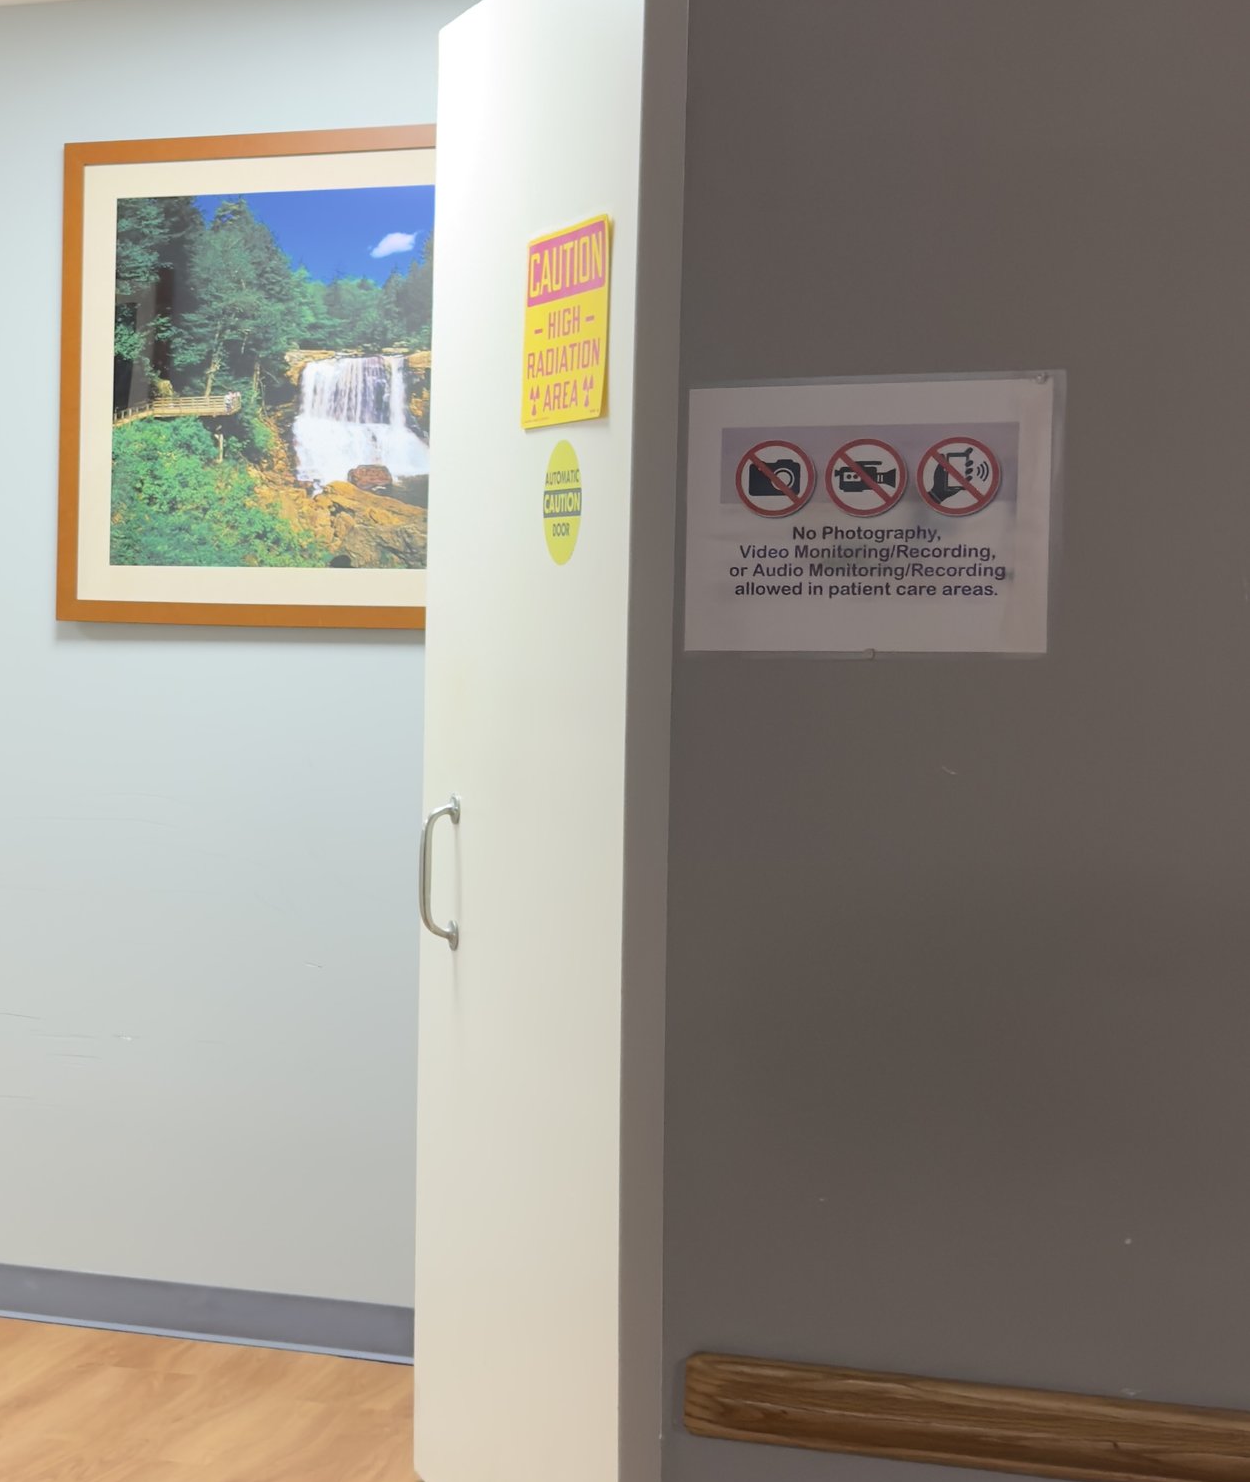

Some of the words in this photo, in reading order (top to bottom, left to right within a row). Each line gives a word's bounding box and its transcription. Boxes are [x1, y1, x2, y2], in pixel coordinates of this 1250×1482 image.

[530, 230, 603, 299] CAUTION
[548, 305, 580, 339] HIGH
[527, 337, 600, 380] RADIATION
[543, 379, 579, 412] AREA
[545, 468, 580, 485] AUTOMATIC
[544, 492, 581, 514] CAUTION
[552, 522, 570, 537] DOOR
[792, 526, 817, 540] No
[822, 525, 941, 543] Photography,
[740, 545, 789, 559] Video
[795, 544, 996, 561] Monitoring/Recording,
[729, 566, 748, 577] or
[752, 563, 804, 577] Audio
[735, 582, 802, 596] allowed
[808, 582, 823, 596] in
[829, 581, 891, 599] patient
[896, 585, 937, 596] care
[942, 585, 998, 596] areas.
